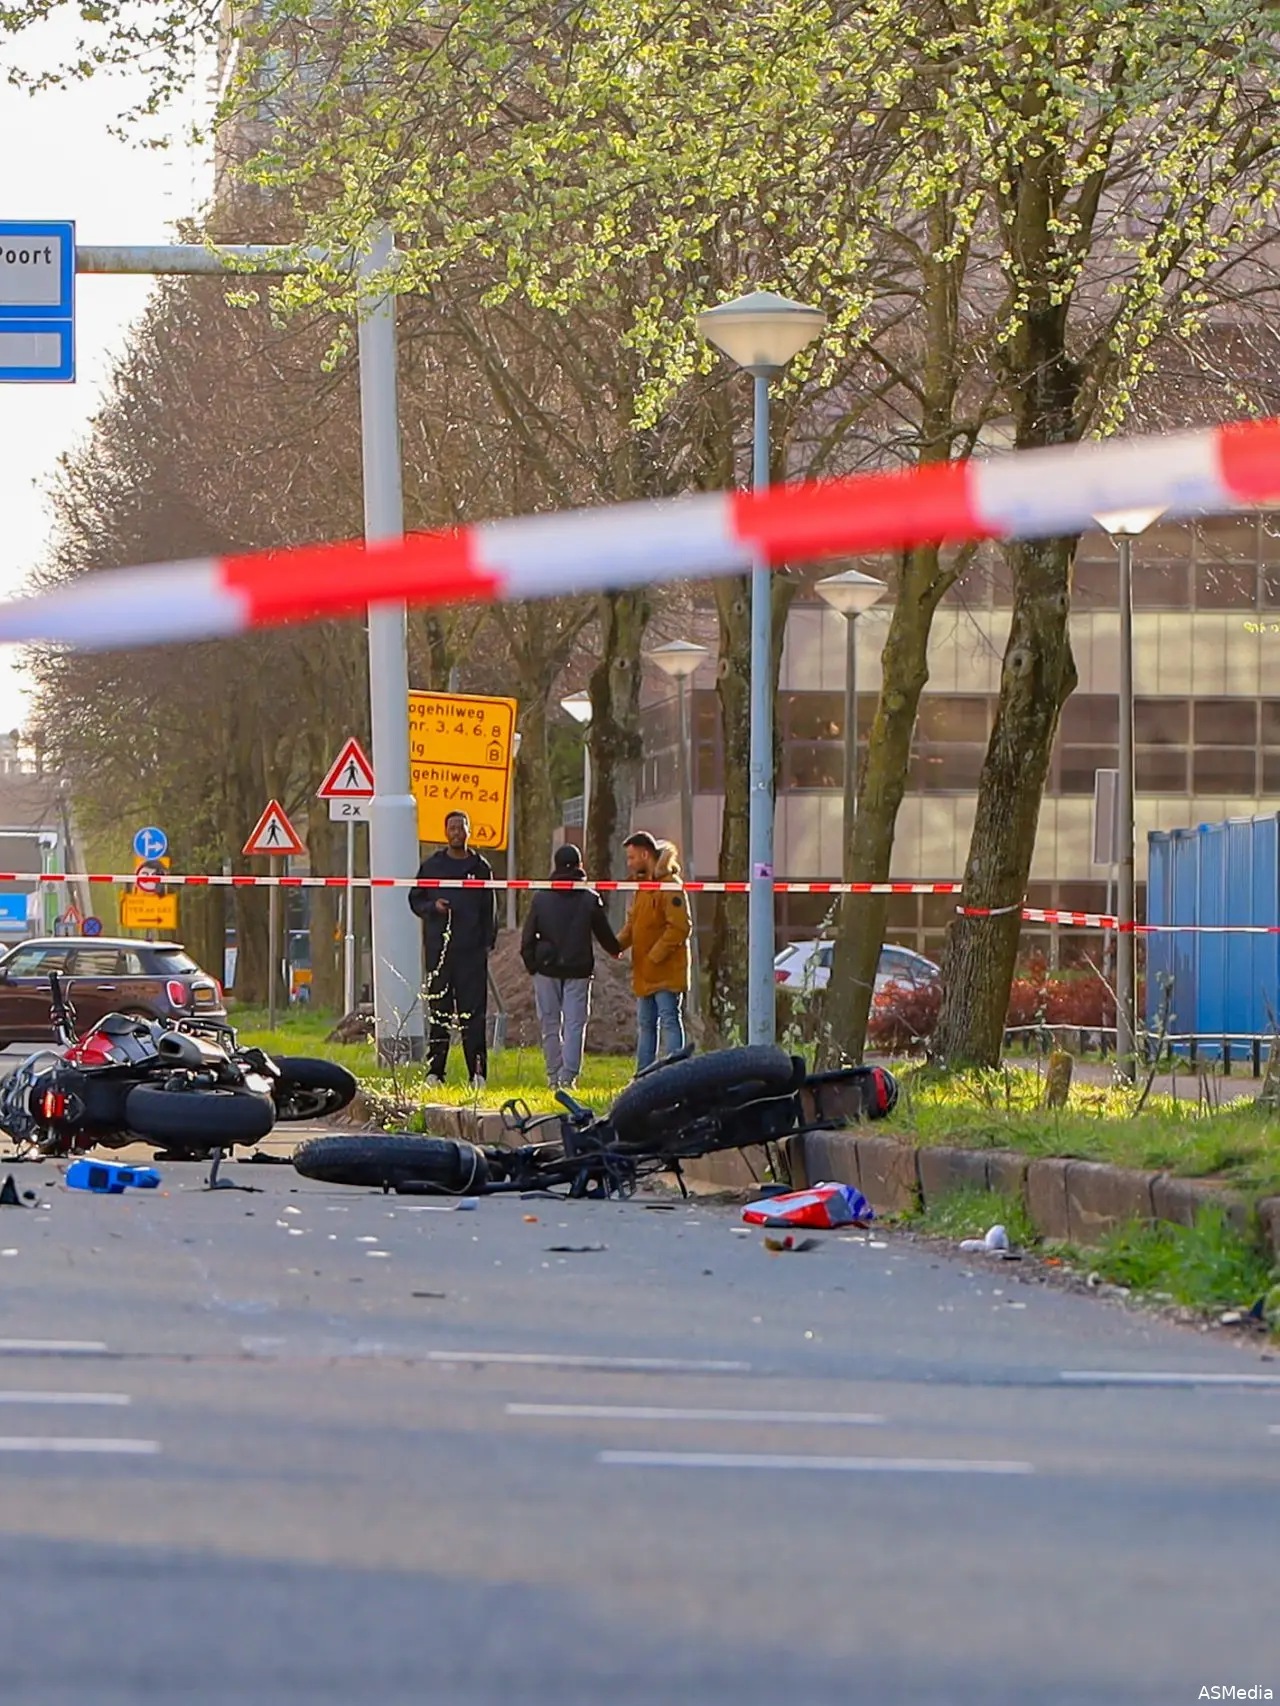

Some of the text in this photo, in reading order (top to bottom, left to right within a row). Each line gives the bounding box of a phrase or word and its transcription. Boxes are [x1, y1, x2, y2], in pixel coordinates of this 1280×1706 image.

[408, 703, 484, 723] ogehilweg
[491, 725, 501, 738] 8
[412, 768, 479, 787] gehilweg
[424, 784, 499, 803] 12 t/m 24
[342, 803, 361, 816] 2x
